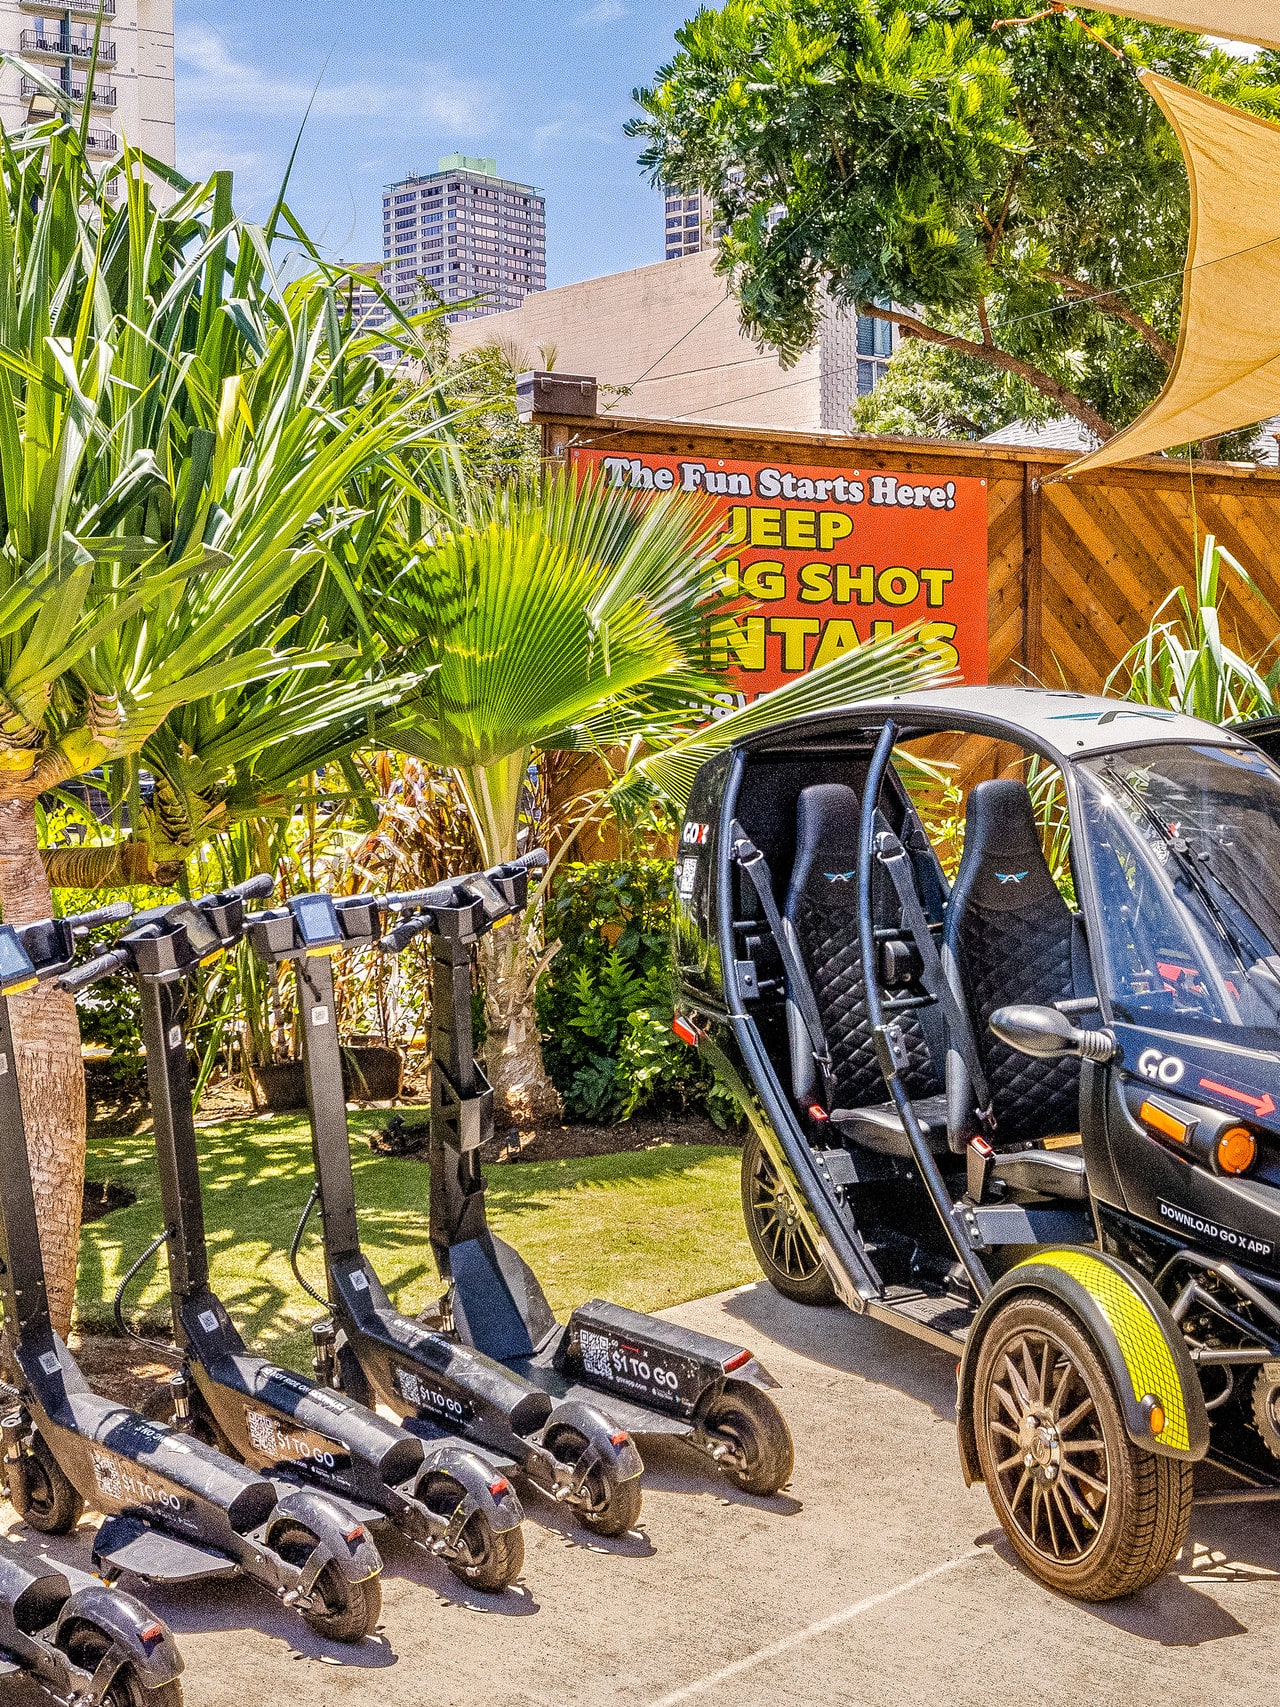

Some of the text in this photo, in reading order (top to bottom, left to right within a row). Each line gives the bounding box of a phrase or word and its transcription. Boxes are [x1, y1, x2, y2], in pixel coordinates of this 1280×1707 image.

[604, 457, 956, 510] The Fun Starts Here!
[720, 506, 853, 550] JEEP
[801, 562, 954, 606] SHOT
[1138, 1047, 1186, 1084] GO
[1160, 1203, 1271, 1256] DOWNLOAD GO X APP
[612, 1350, 679, 1390] $1 TO GO
[418, 1385, 431, 1401] $1
[431, 1391, 446, 1406] TO
[447, 1398, 463, 1414] GO
[276, 1431, 291, 1451] $1
[292, 1438, 311, 1458] TO
[313, 1448, 335, 1468] GO
[121, 1473, 137, 1492] $1
[137, 1479, 155, 1501] TO
[158, 1491, 181, 1511] GO
